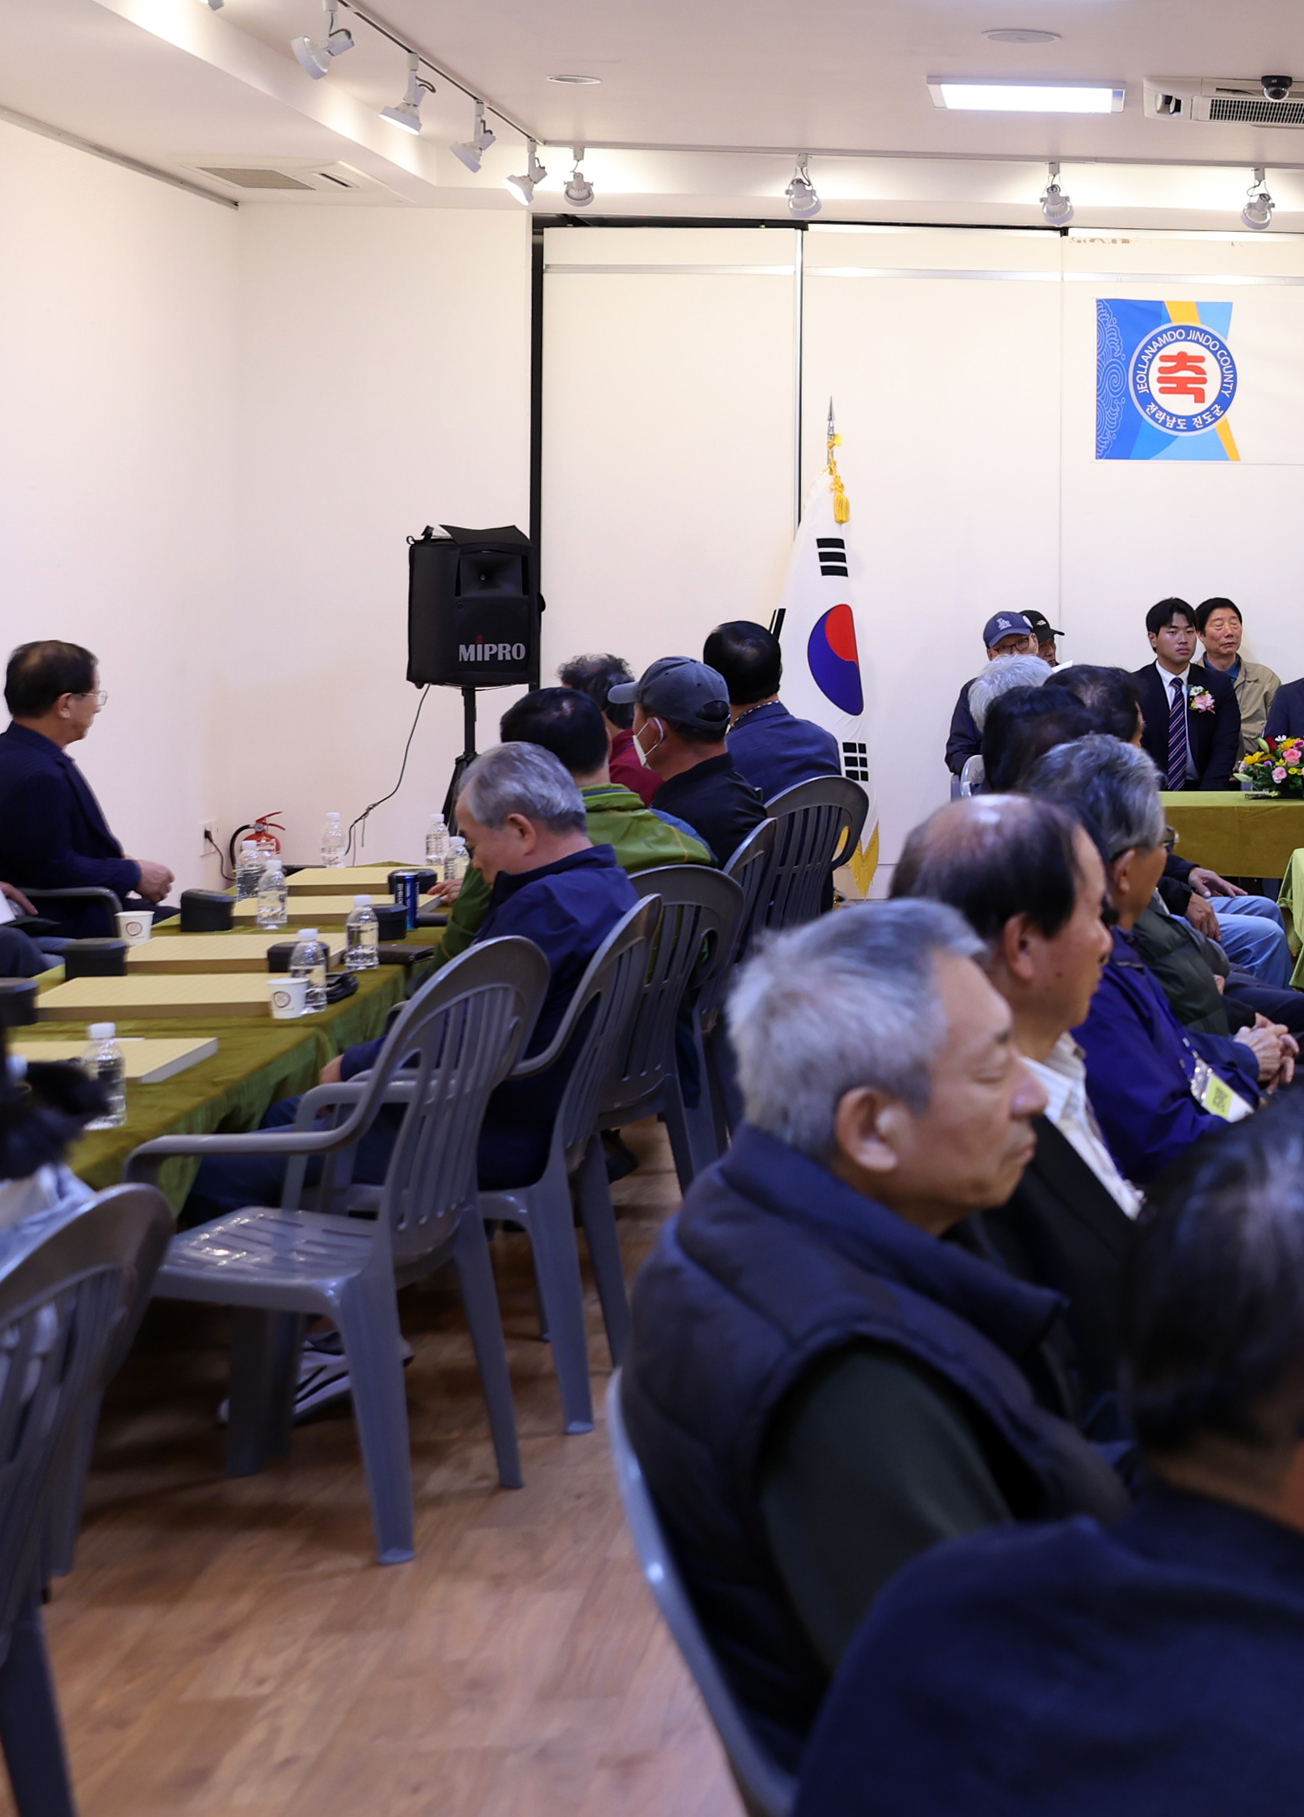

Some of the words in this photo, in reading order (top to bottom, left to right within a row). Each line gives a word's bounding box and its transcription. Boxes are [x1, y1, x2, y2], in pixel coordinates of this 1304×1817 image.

[1136, 329, 1185, 394] JEOLLANAMDO
[1187, 329, 1220, 351] JINDO
[1216, 351, 1234, 398] COUNTY
[1157, 351, 1207, 403] 축
[1146, 402, 1187, 430] 전라남도
[1192, 403, 1224, 429] 진도군
[459, 643, 526, 661] MIPRO
